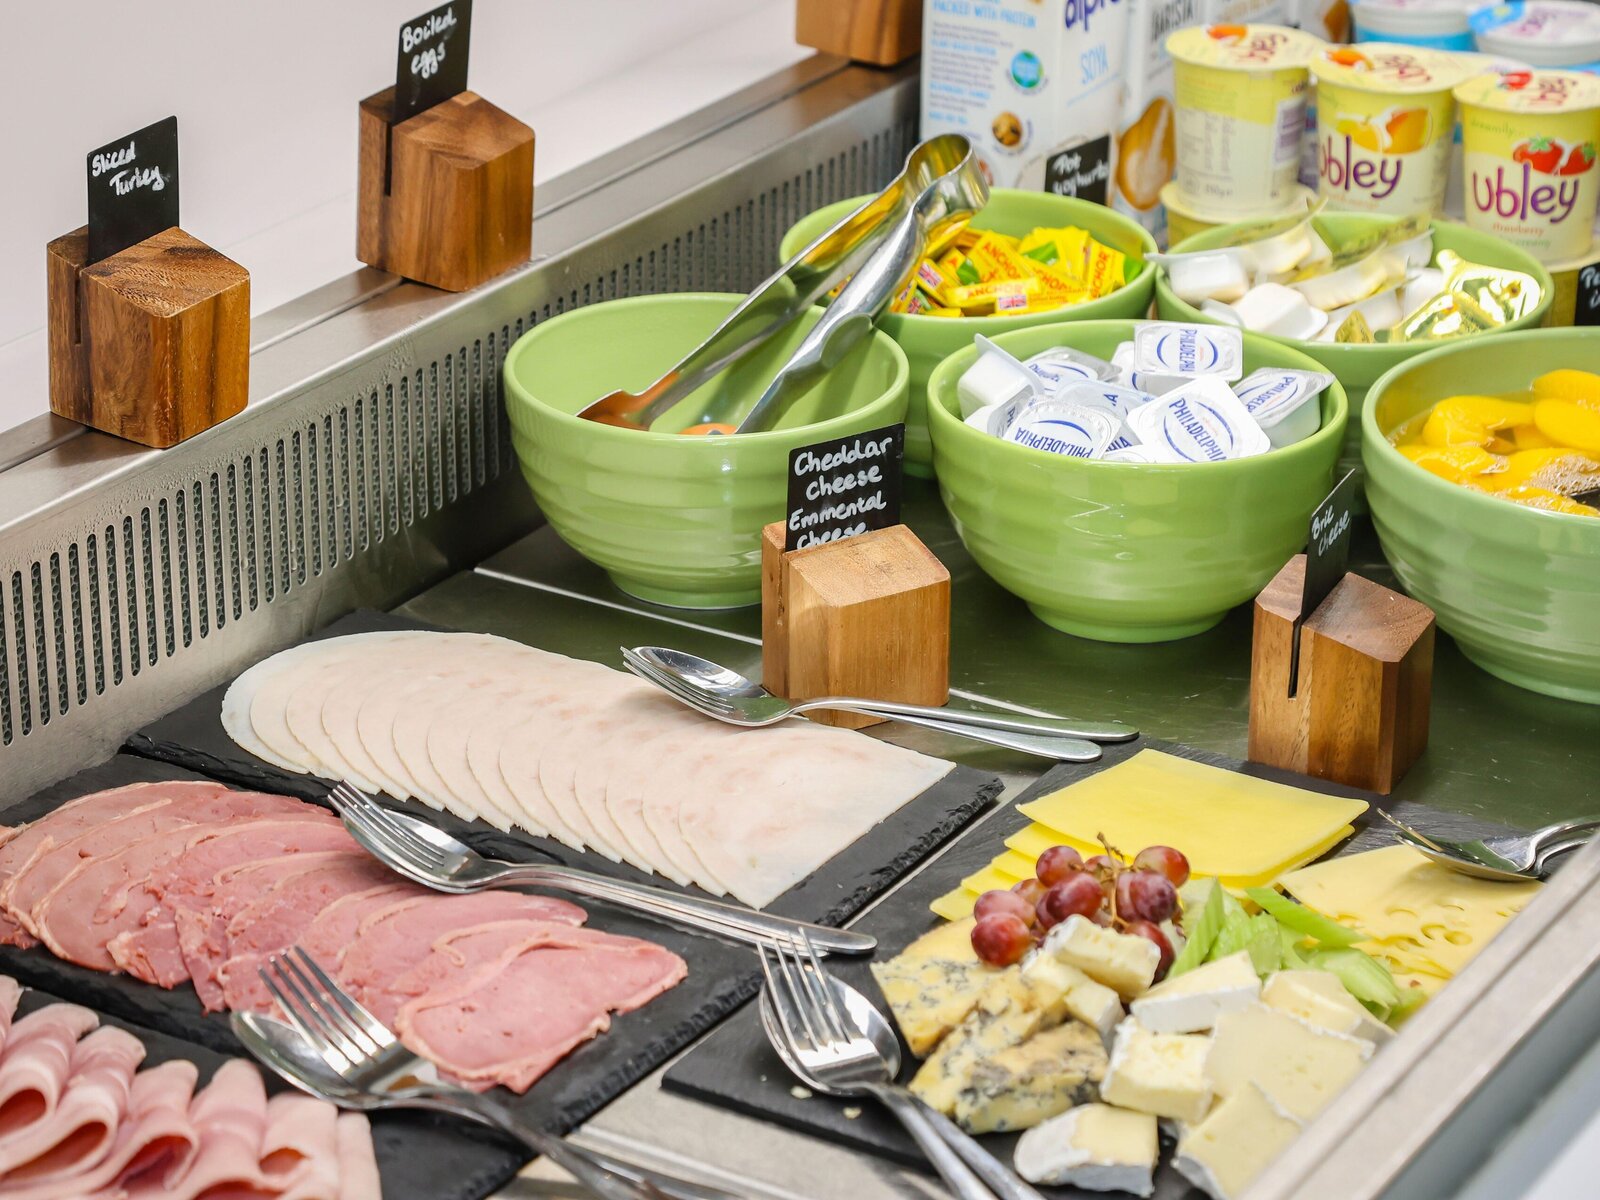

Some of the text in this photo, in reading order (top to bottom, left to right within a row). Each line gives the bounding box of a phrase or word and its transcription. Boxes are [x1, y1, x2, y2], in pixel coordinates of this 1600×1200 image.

[402, 6, 457, 53] Boiled
[92, 141, 137, 177] Sliced
[109, 165, 165, 196] Turkey
[794, 437, 892, 476] Cheddar
[789, 490, 886, 531] Emmental
